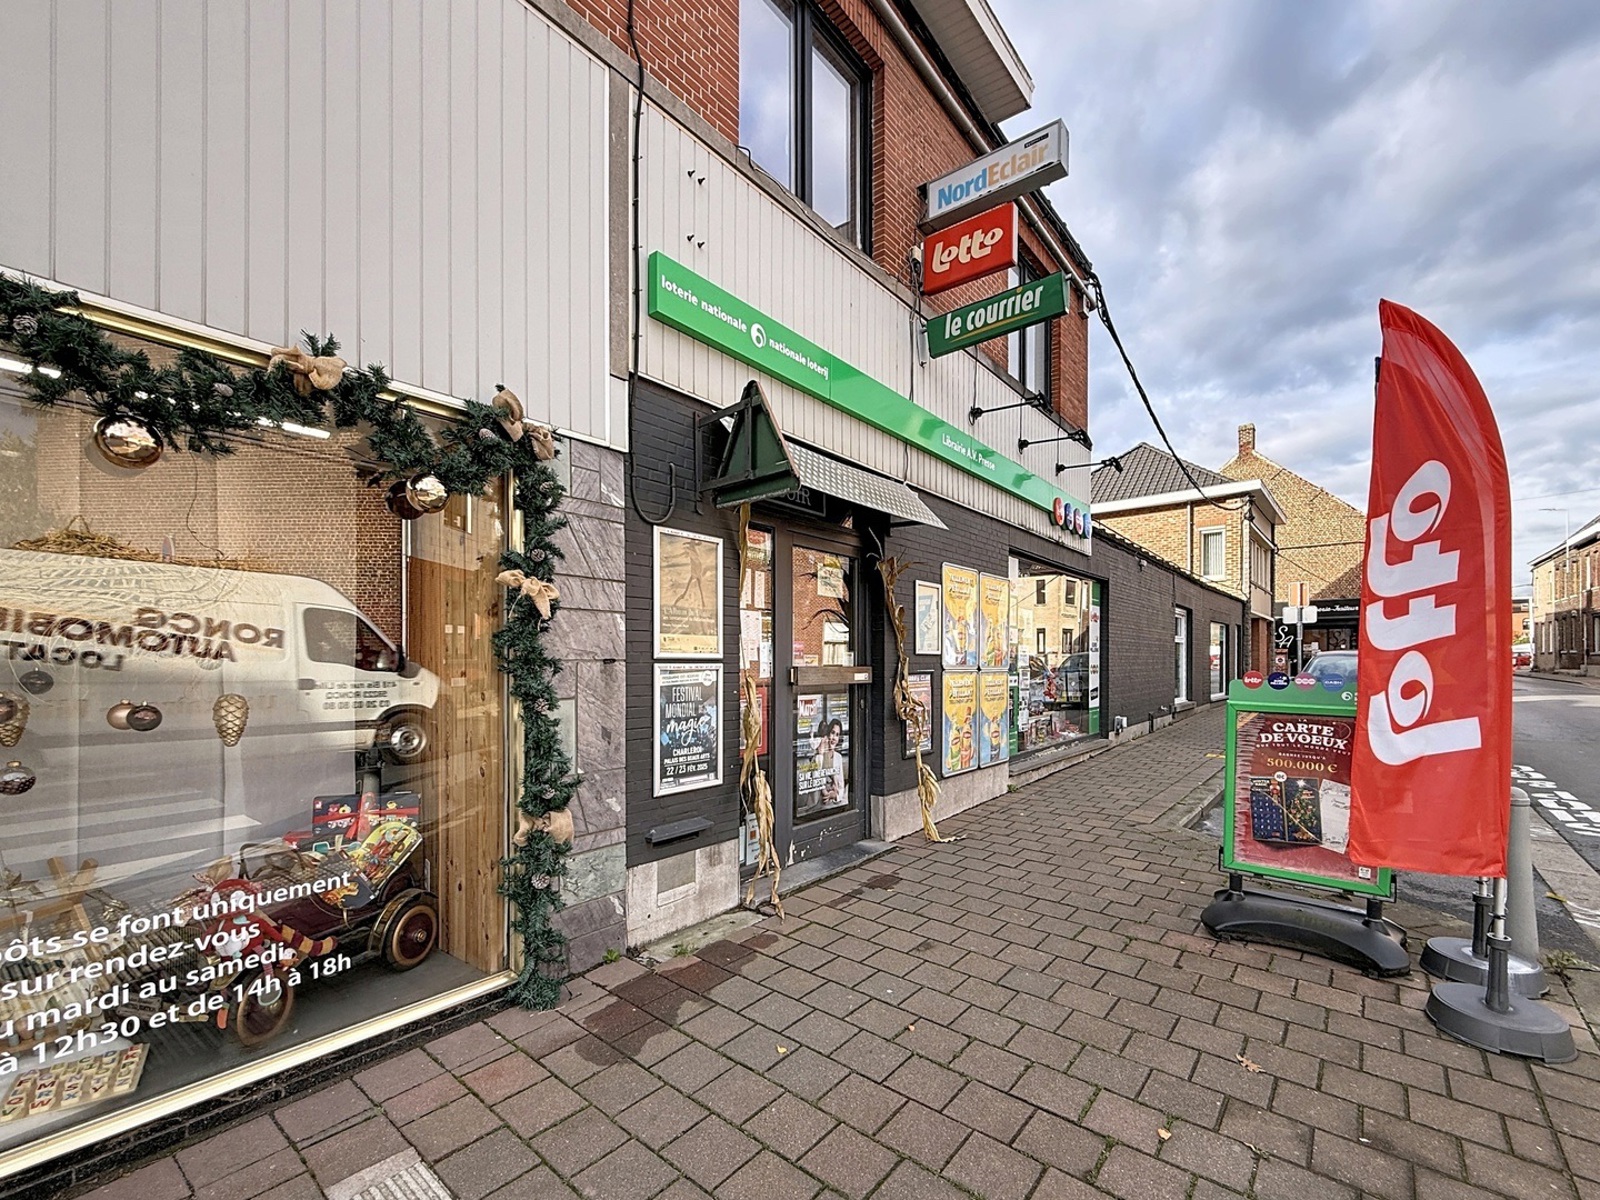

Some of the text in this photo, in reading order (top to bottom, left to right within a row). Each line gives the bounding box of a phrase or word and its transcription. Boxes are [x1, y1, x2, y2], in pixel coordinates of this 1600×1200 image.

[937, 143, 1049, 210] NordEclair
[661, 274, 748, 333] loterie nationale
[944, 285, 1044, 340] le courrier
[769, 338, 829, 381] nationale loterij
[942, 433, 967, 457] Librairie
[978, 453, 996, 471] Presse
[665, 702, 696, 719] MONDIAL
[671, 686, 703, 703] FESTIVAL
[1259, 733, 1348, 750] DE VOEUX
[1272, 722, 1334, 736] CARTE
[666, 766, 675, 776] 22
[679, 765, 687, 774] 23
[1266, 758, 1338, 773] 500.000 €
[0, 871, 351, 962] ôts se font uniquement
[0, 922, 260, 1001] sur rendez-vous
[27, 982, 130, 1031] mardi
[139, 974, 177, 999] au
[186, 941, 285, 987] samedi
[32, 1015, 140, 1064] 12h30
[150, 1004, 180, 1028] et
[187, 989, 224, 1017] de
[233, 975, 281, 1003] 14h
[287, 970, 302, 987] à
[309, 954, 351, 980] 18h
